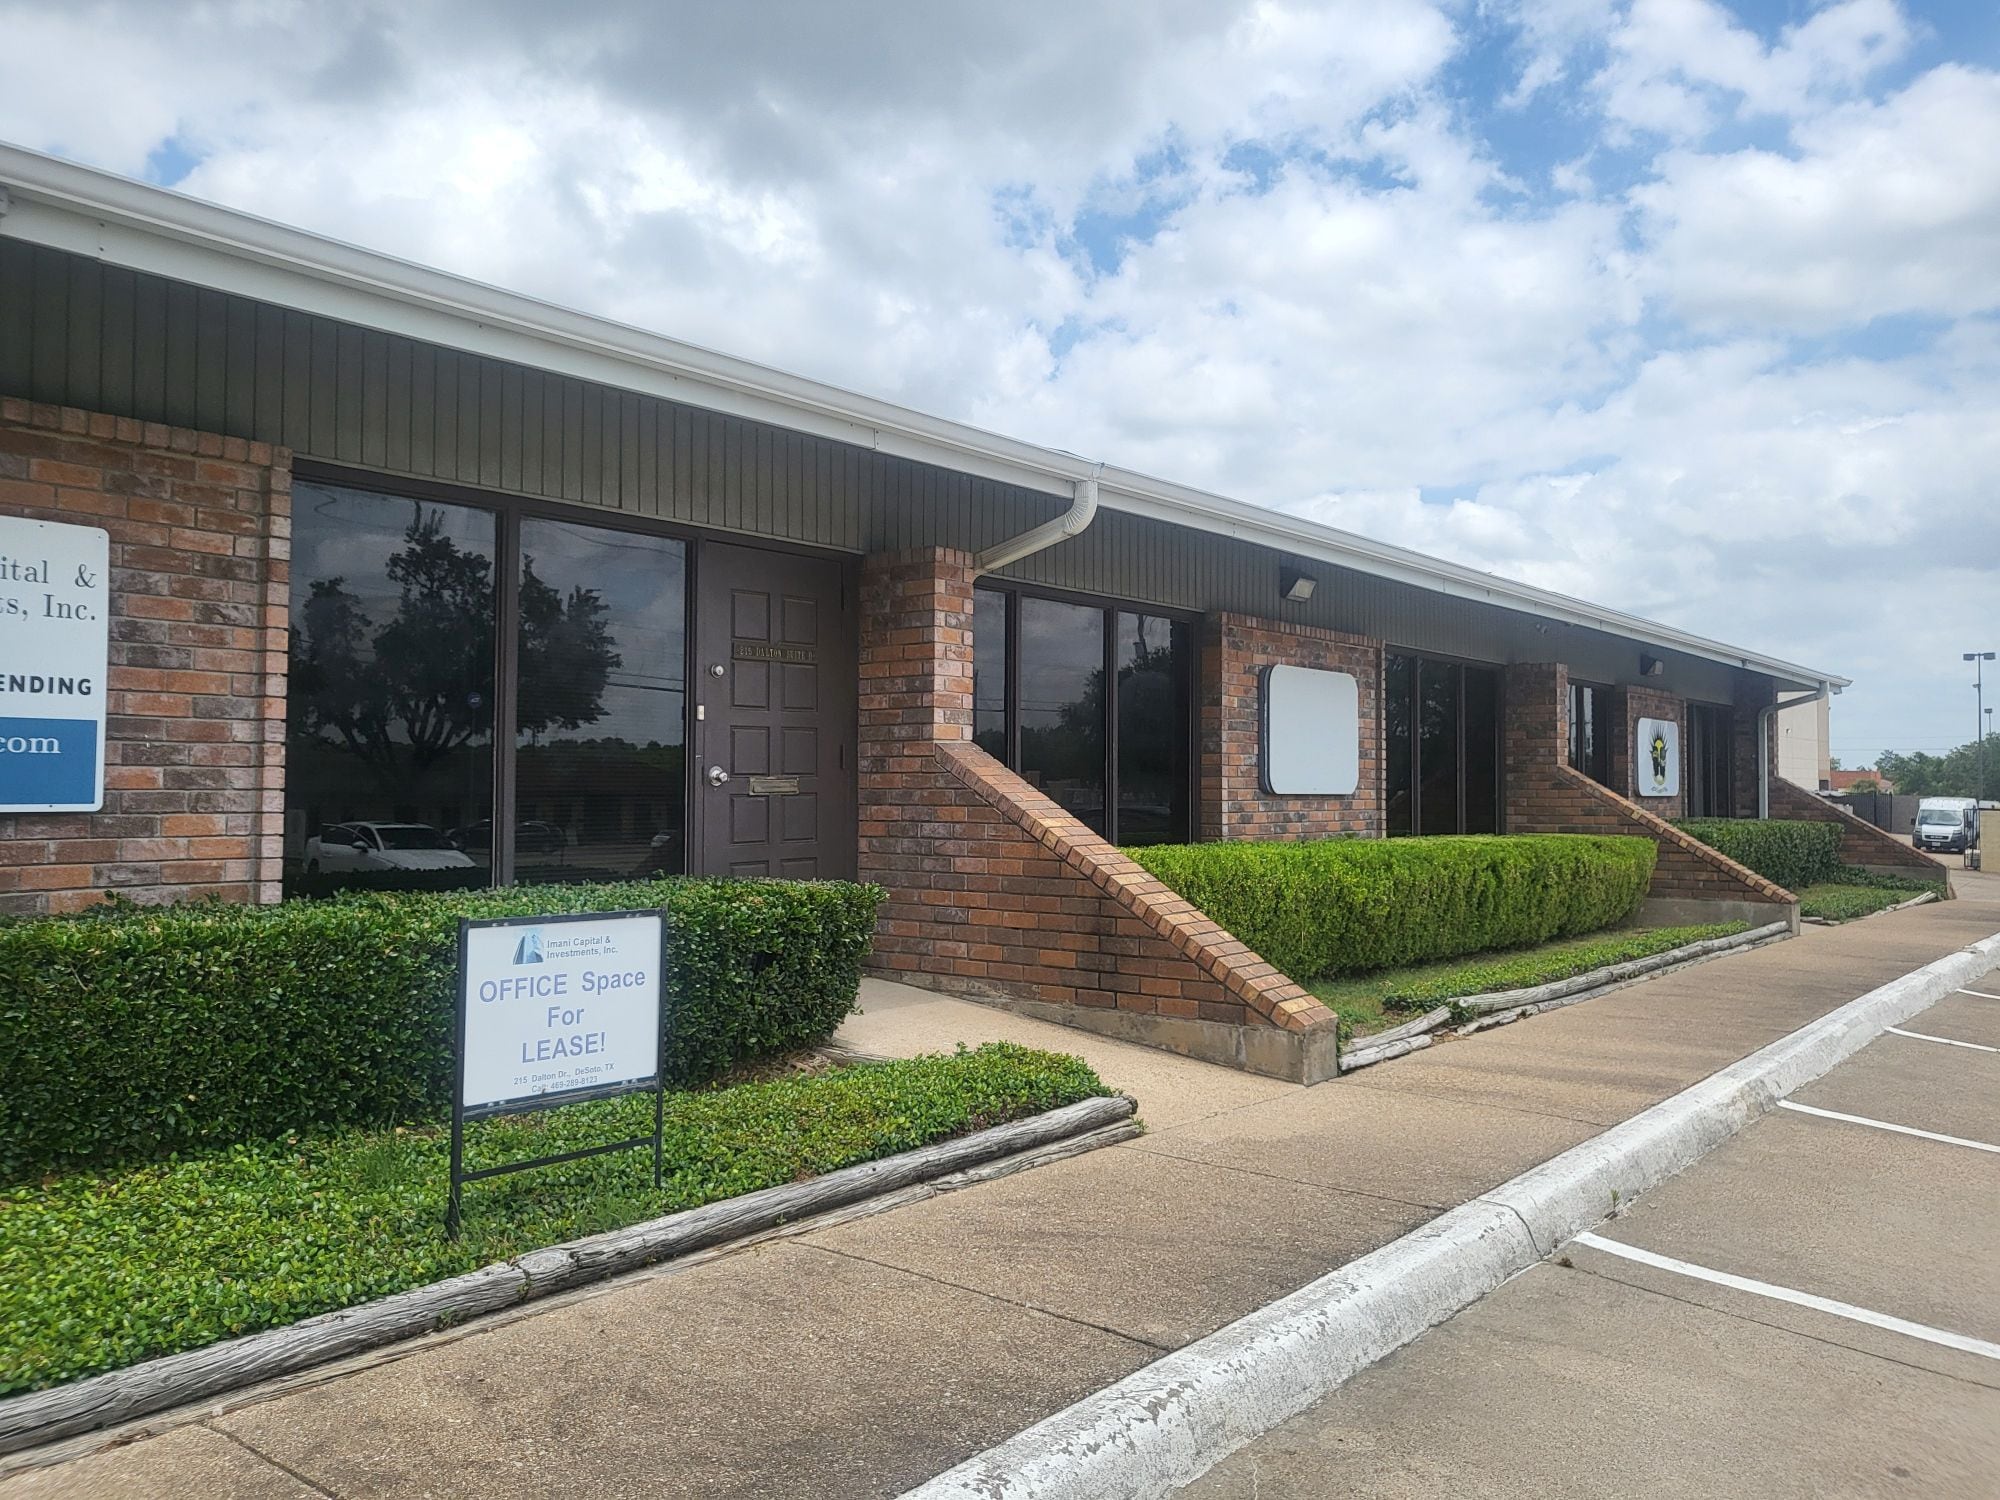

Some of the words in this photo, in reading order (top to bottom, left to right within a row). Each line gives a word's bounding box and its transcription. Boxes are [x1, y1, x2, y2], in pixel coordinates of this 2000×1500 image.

[74, 564, 97, 588] &
[43, 594, 96, 621] Inc.
[547, 938, 571, 949] Imani
[573, 935, 603, 948] Capital
[605, 935, 611, 944] &
[547, 946, 602, 959] Investments,
[603, 945, 619, 954] Inc.
[479, 973, 568, 1003] OFFICE
[581, 970, 646, 996] Space
[547, 1006, 585, 1028] For
[522, 1031, 606, 1064] LEASE!
[514, 1076, 528, 1085] 215
[531, 1072, 557, 1083] Dalton
[575, 1066, 603, 1076] DeSoto,
[604, 1063, 615, 1071] TX
